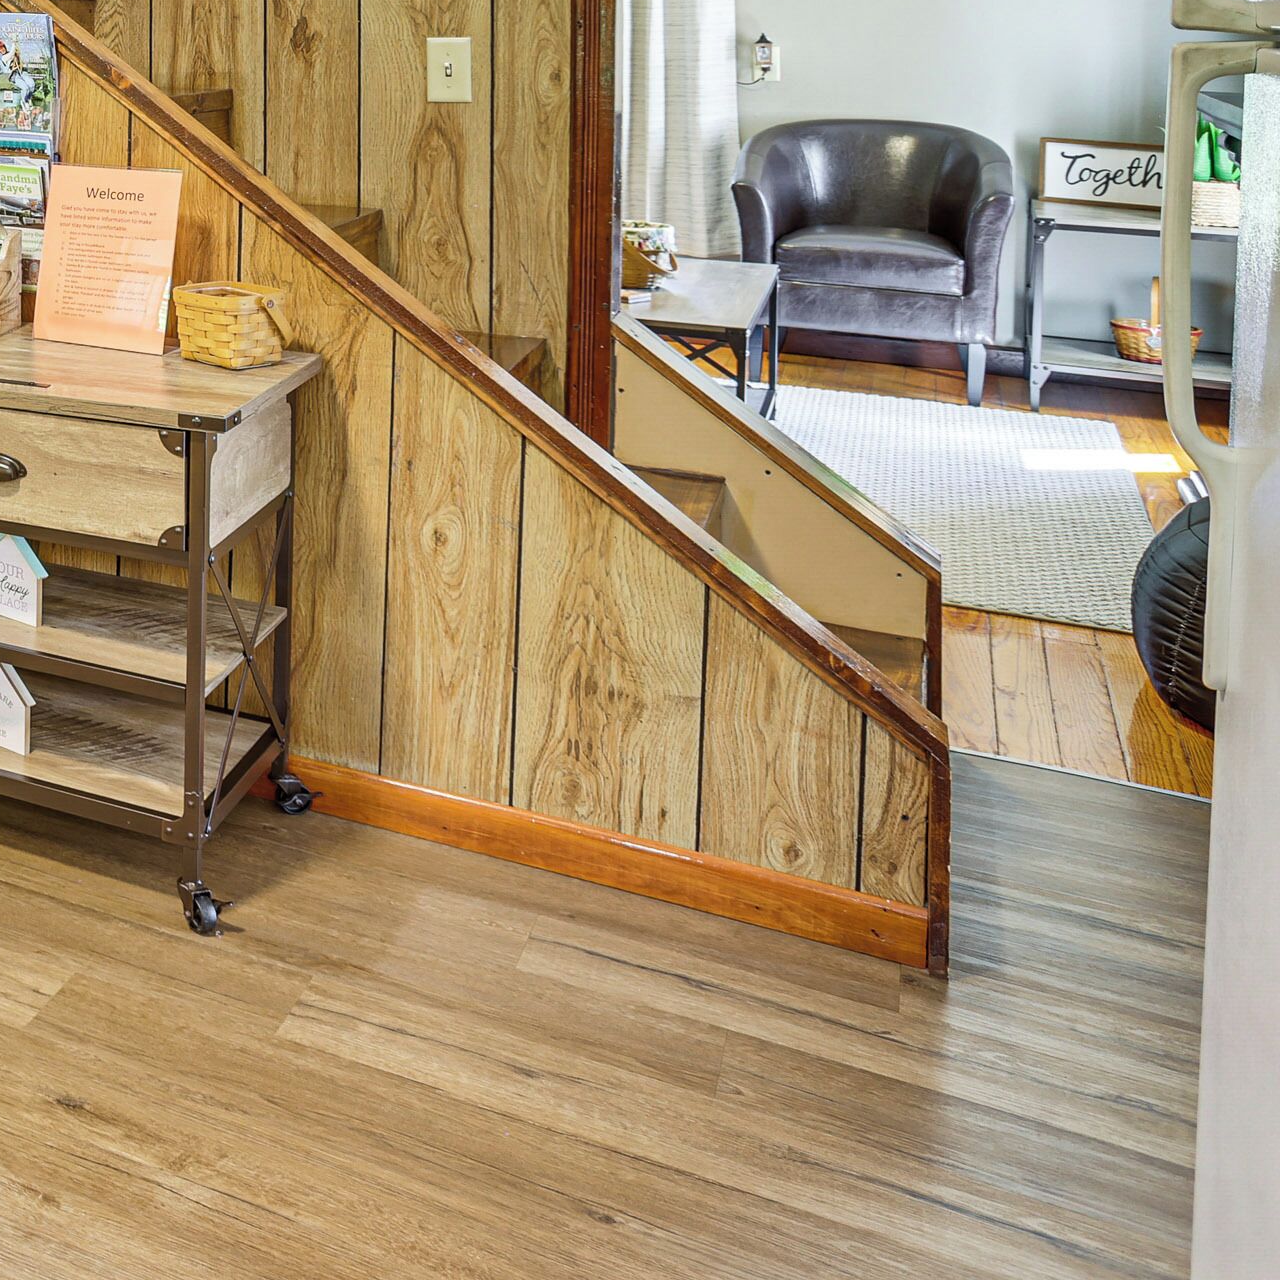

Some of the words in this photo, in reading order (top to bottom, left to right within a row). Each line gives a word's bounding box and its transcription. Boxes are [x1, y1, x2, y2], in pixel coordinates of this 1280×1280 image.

[1060, 151, 1164, 197] Togeth
[0, 182, 32, 195] Faye's
[86, 187, 145, 202] Welcome
